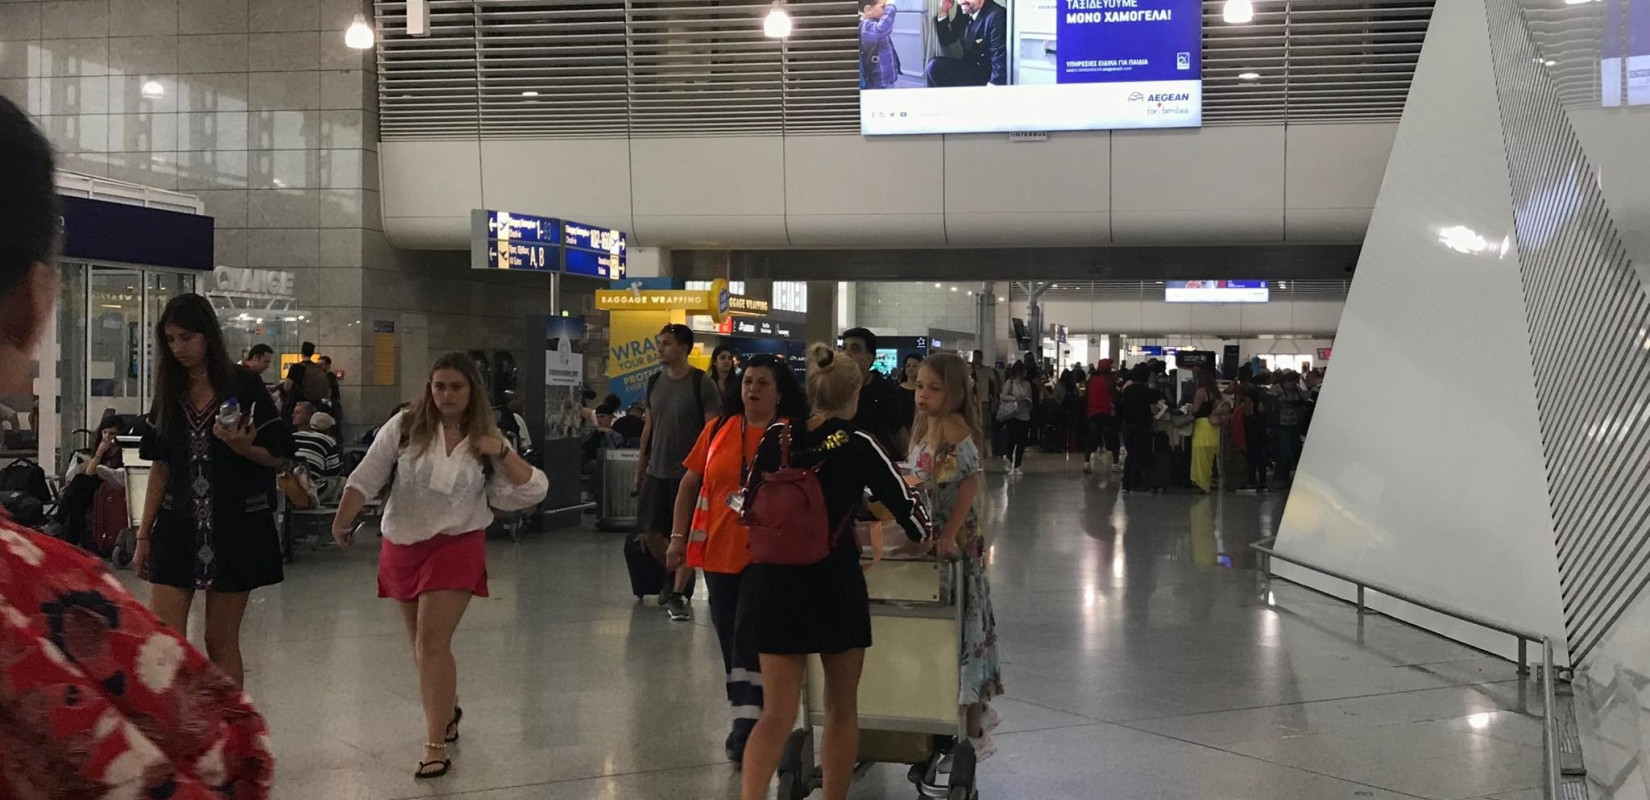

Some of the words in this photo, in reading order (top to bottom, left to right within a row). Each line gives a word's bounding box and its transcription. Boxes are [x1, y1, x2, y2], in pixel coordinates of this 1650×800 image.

[1066, 12, 1101, 24] ΜΟΝΟ
[1104, 9, 1172, 23] ΧΑΜΟΓΕΛΑ!
[1147, 93, 1189, 102] AEGEAN
[538, 246, 545, 267] B
[601, 296, 648, 304] BAGGAGE
[650, 295, 702, 305] WRAPPING
[617, 356, 644, 370] YOUR
